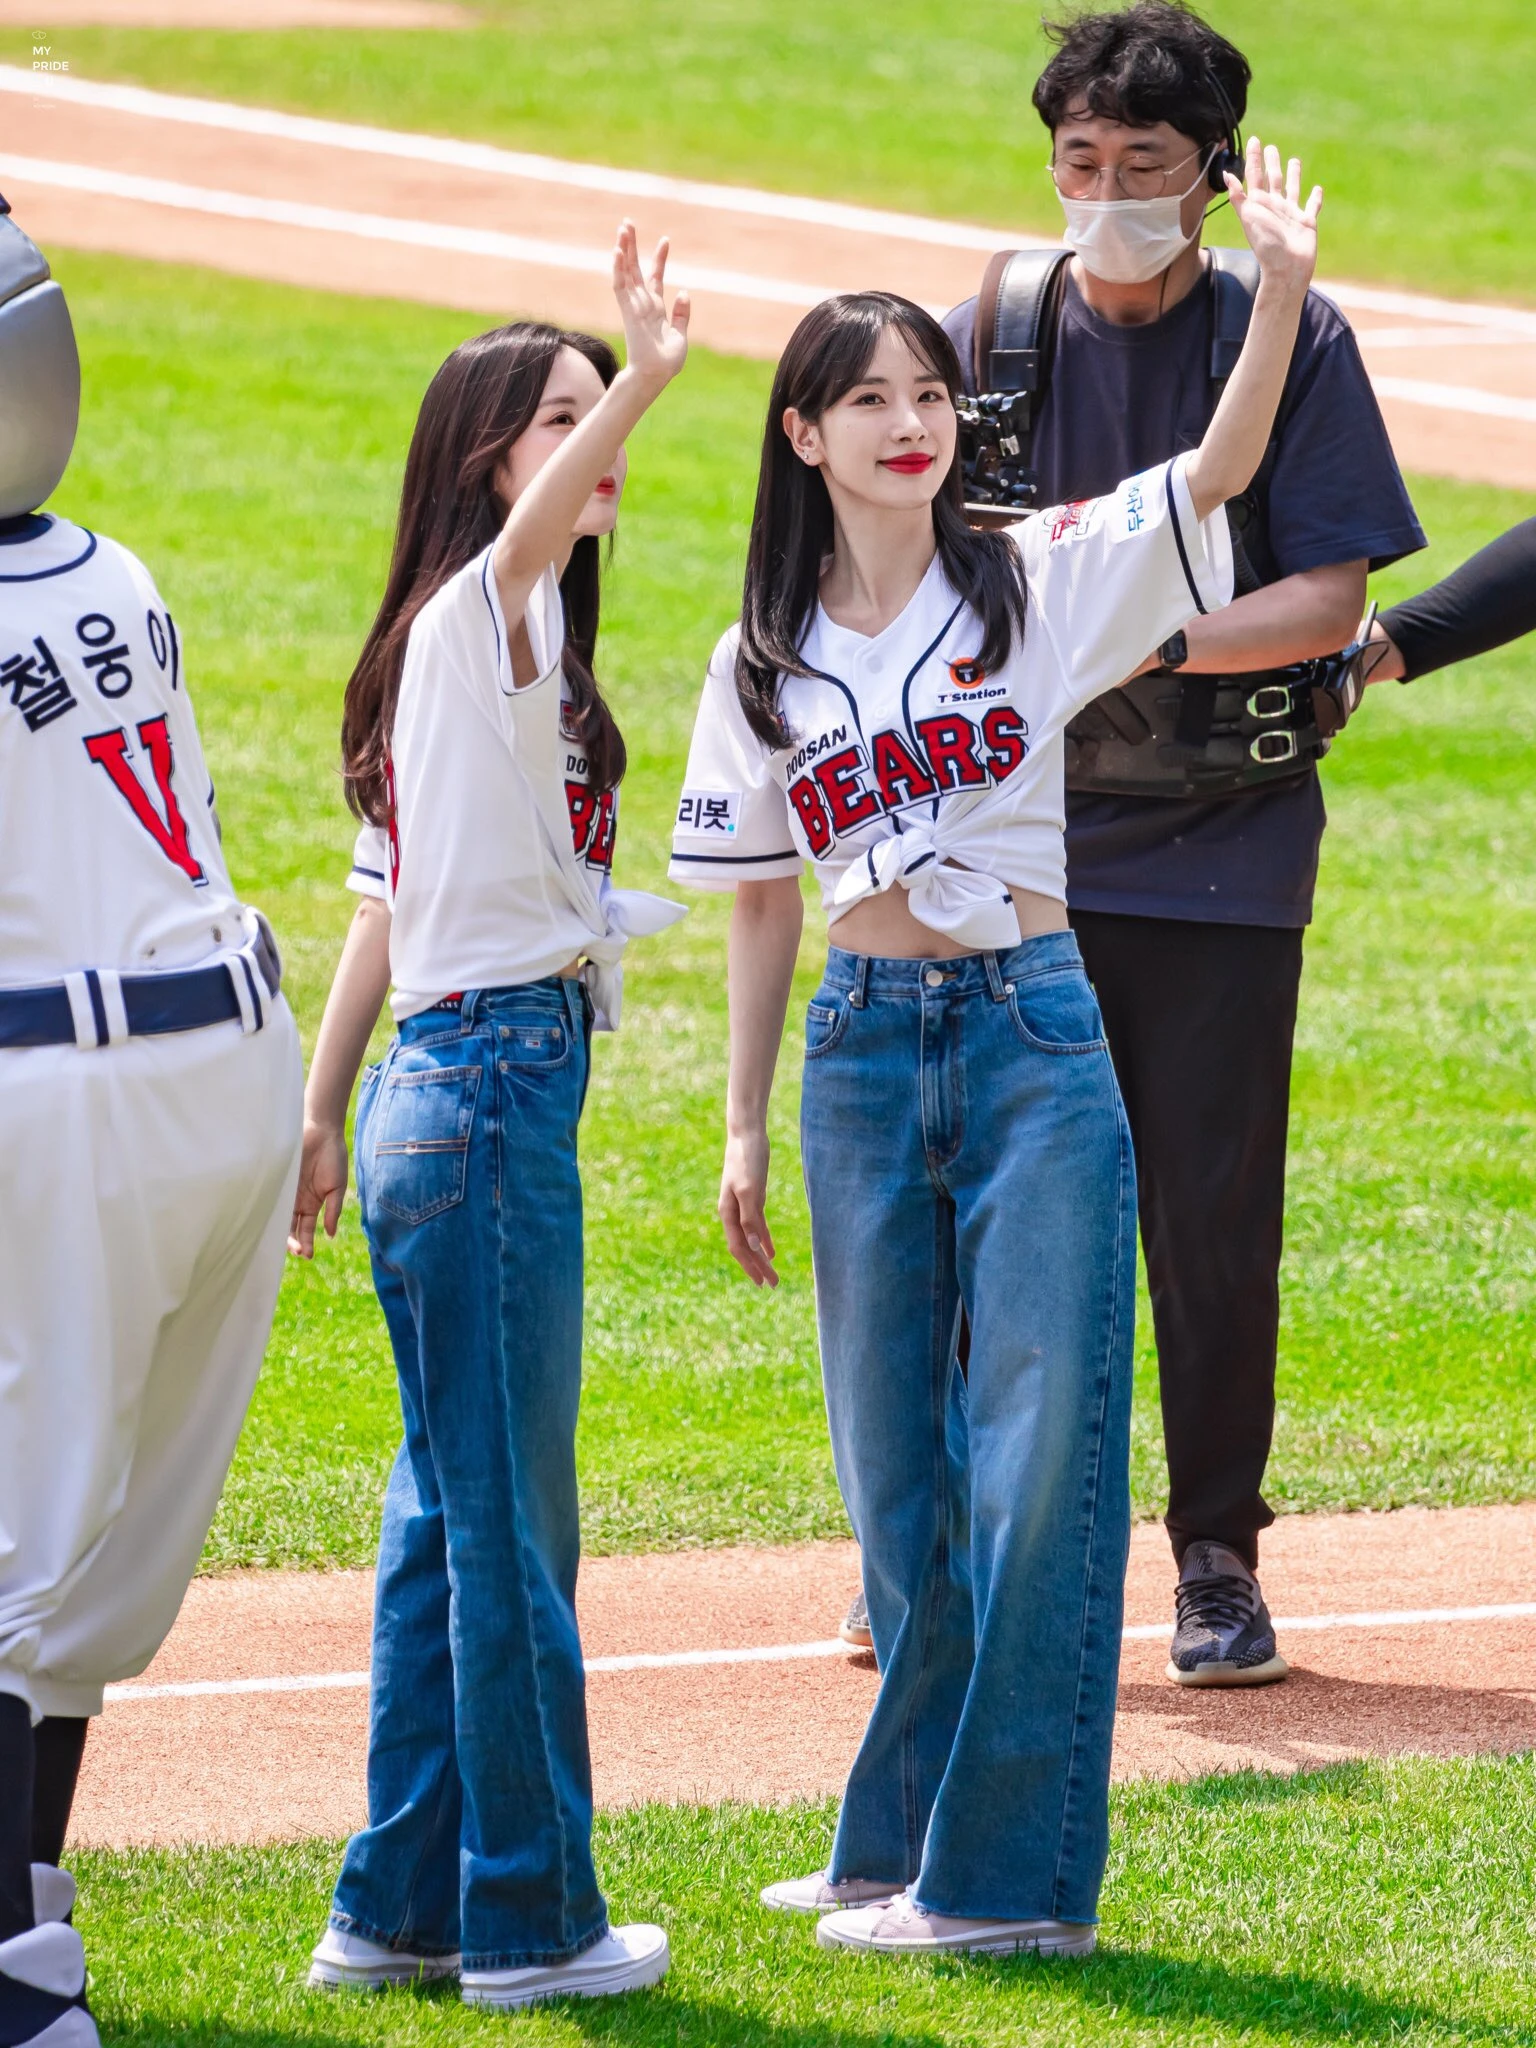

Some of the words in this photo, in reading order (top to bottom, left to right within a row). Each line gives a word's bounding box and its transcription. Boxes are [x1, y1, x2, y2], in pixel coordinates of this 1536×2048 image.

[0, 608, 180, 733] 철웅이
[81, 712, 209, 888] V
[566, 754, 588, 775] DO
[785, 724, 848, 782] DOOSAN
[787, 706, 1030, 862] BEARS
